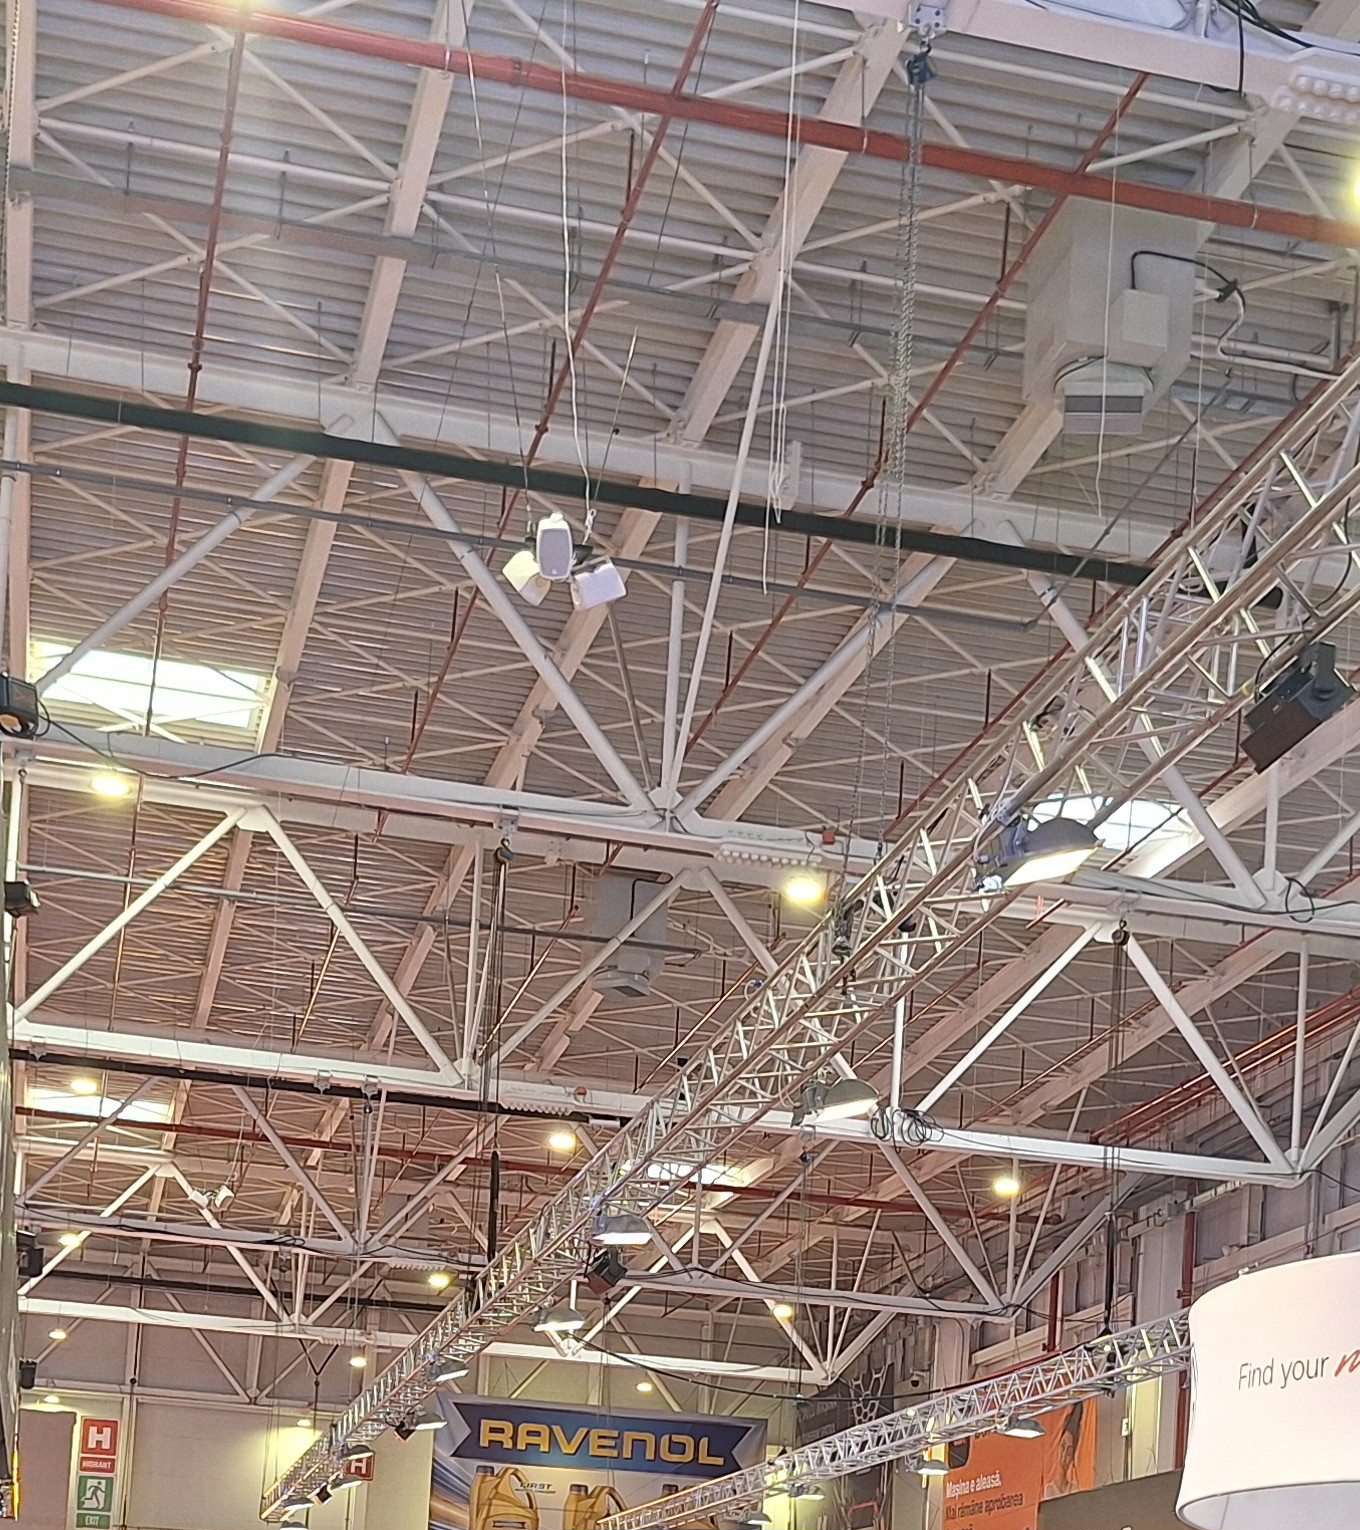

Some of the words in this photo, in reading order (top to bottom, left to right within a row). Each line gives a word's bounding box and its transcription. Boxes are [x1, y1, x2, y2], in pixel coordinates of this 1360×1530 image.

[1238, 1357, 1274, 1391] Find
[1280, 1356, 1329, 1389] your
[87, 1426, 112, 1450] H
[479, 1418, 725, 1466] RAVENOL
